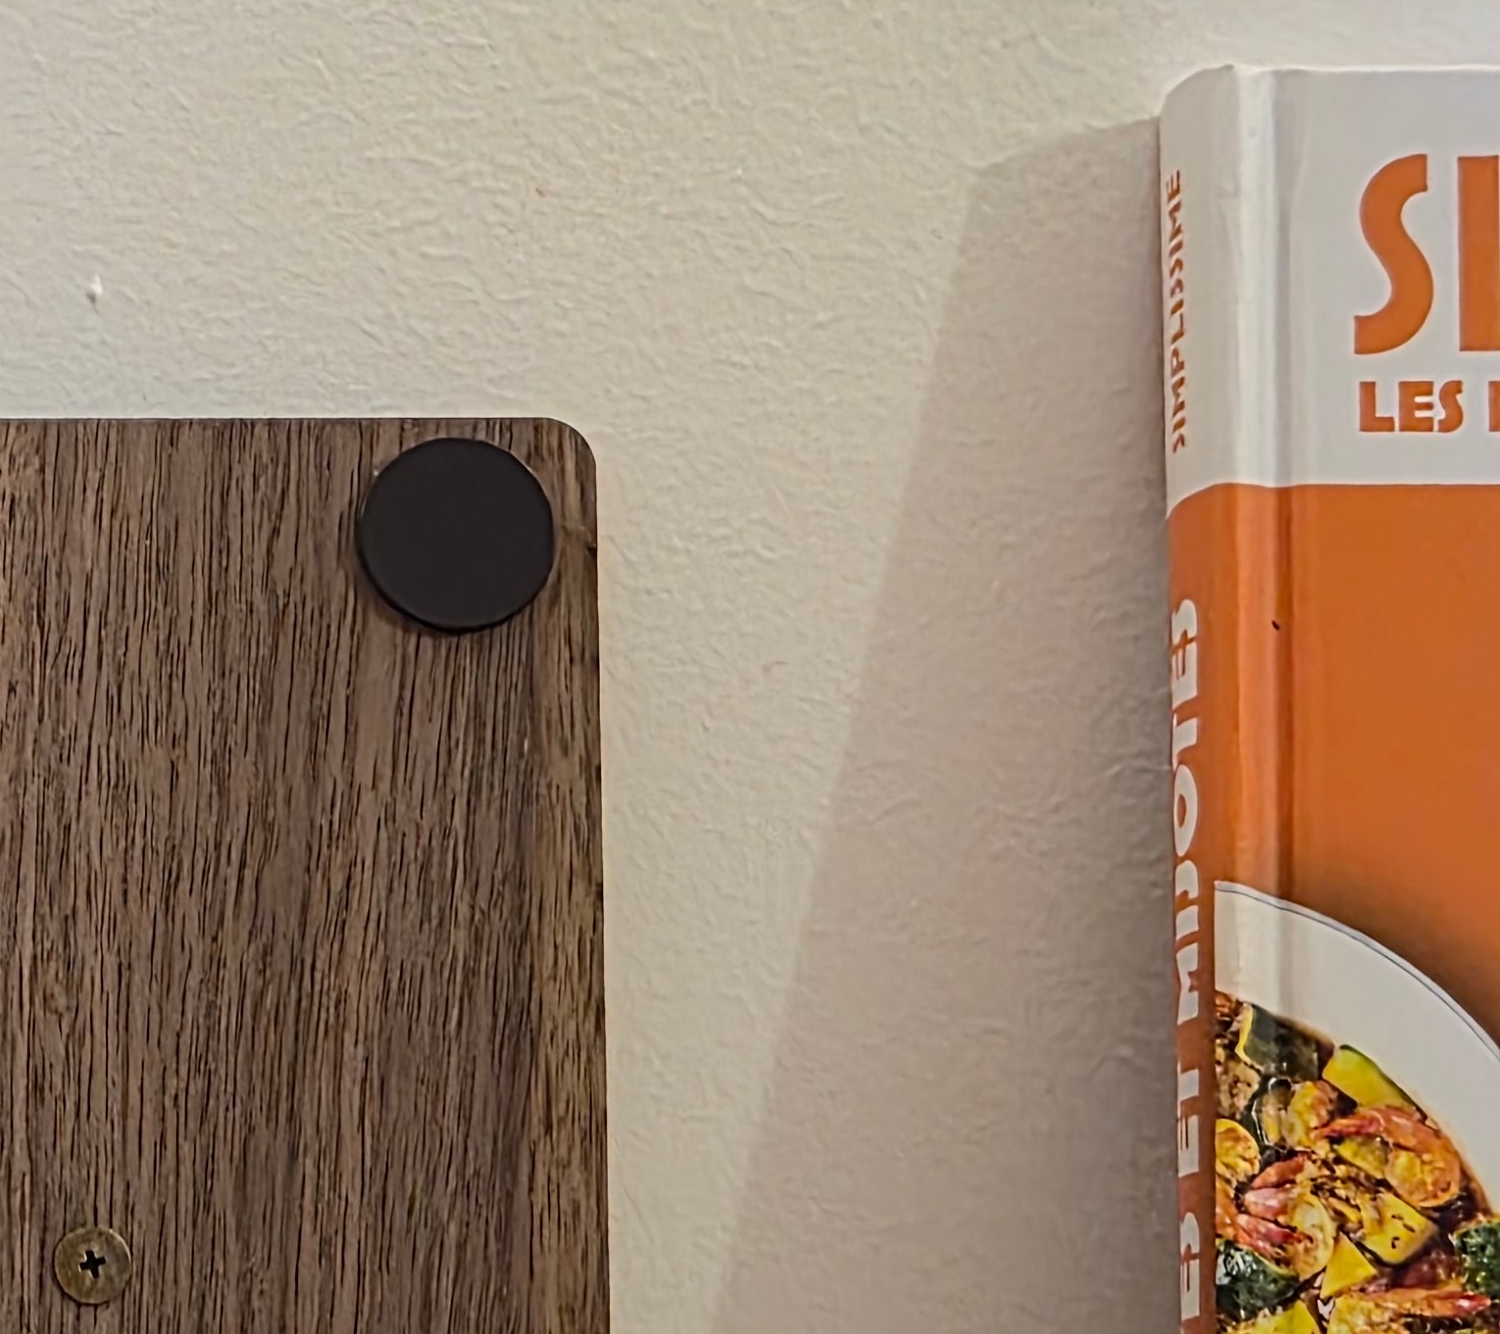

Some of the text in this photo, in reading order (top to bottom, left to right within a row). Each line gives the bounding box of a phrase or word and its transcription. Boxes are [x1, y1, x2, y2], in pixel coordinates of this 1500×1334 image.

[1165, 169, 1186, 454] SIMPLISSIME
[1353, 153, 1499, 355] SI
[1357, 379, 1464, 433] LES
[1176, 1060, 1200, 1178] ET
